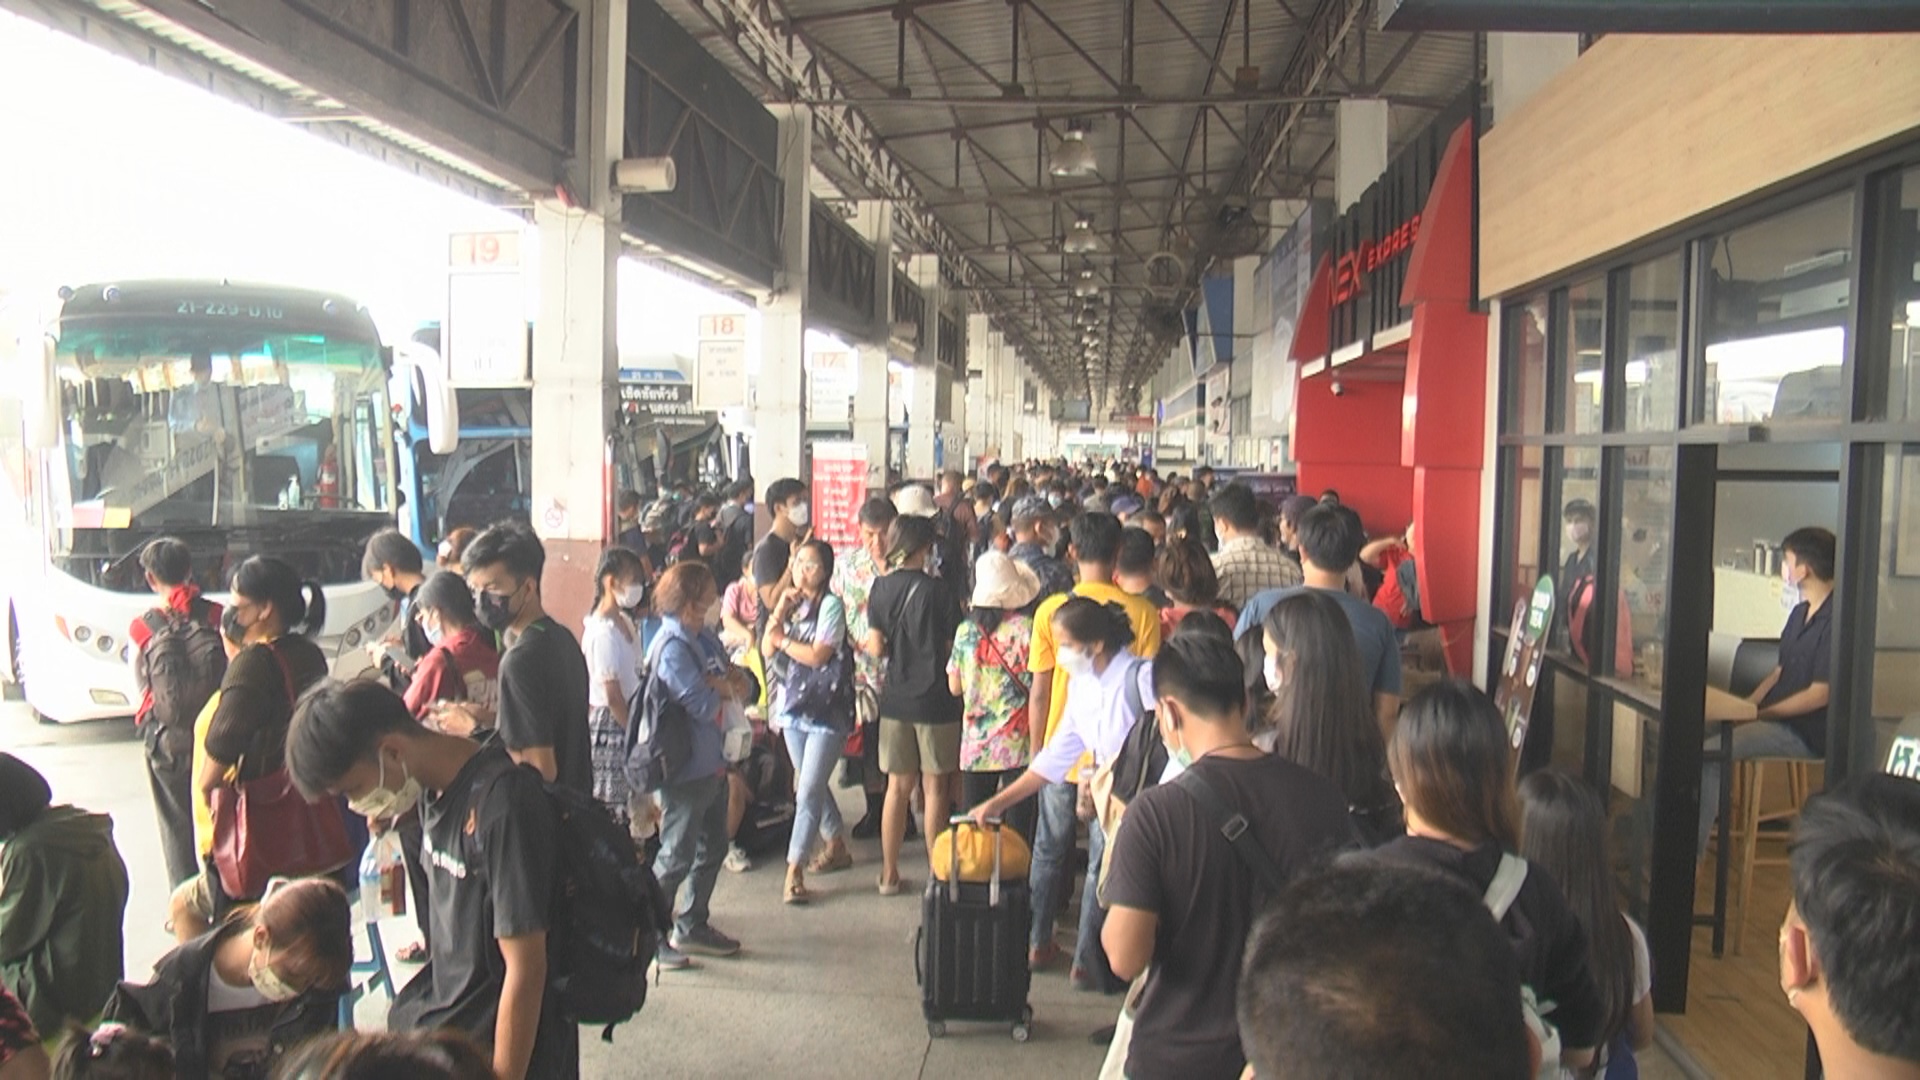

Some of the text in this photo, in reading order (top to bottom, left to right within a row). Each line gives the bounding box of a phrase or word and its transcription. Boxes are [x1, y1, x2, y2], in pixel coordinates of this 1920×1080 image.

[469, 233, 500, 264] 19
[1328, 215, 1420, 305] NEX EXPRES
[712, 316, 734, 335] 18
